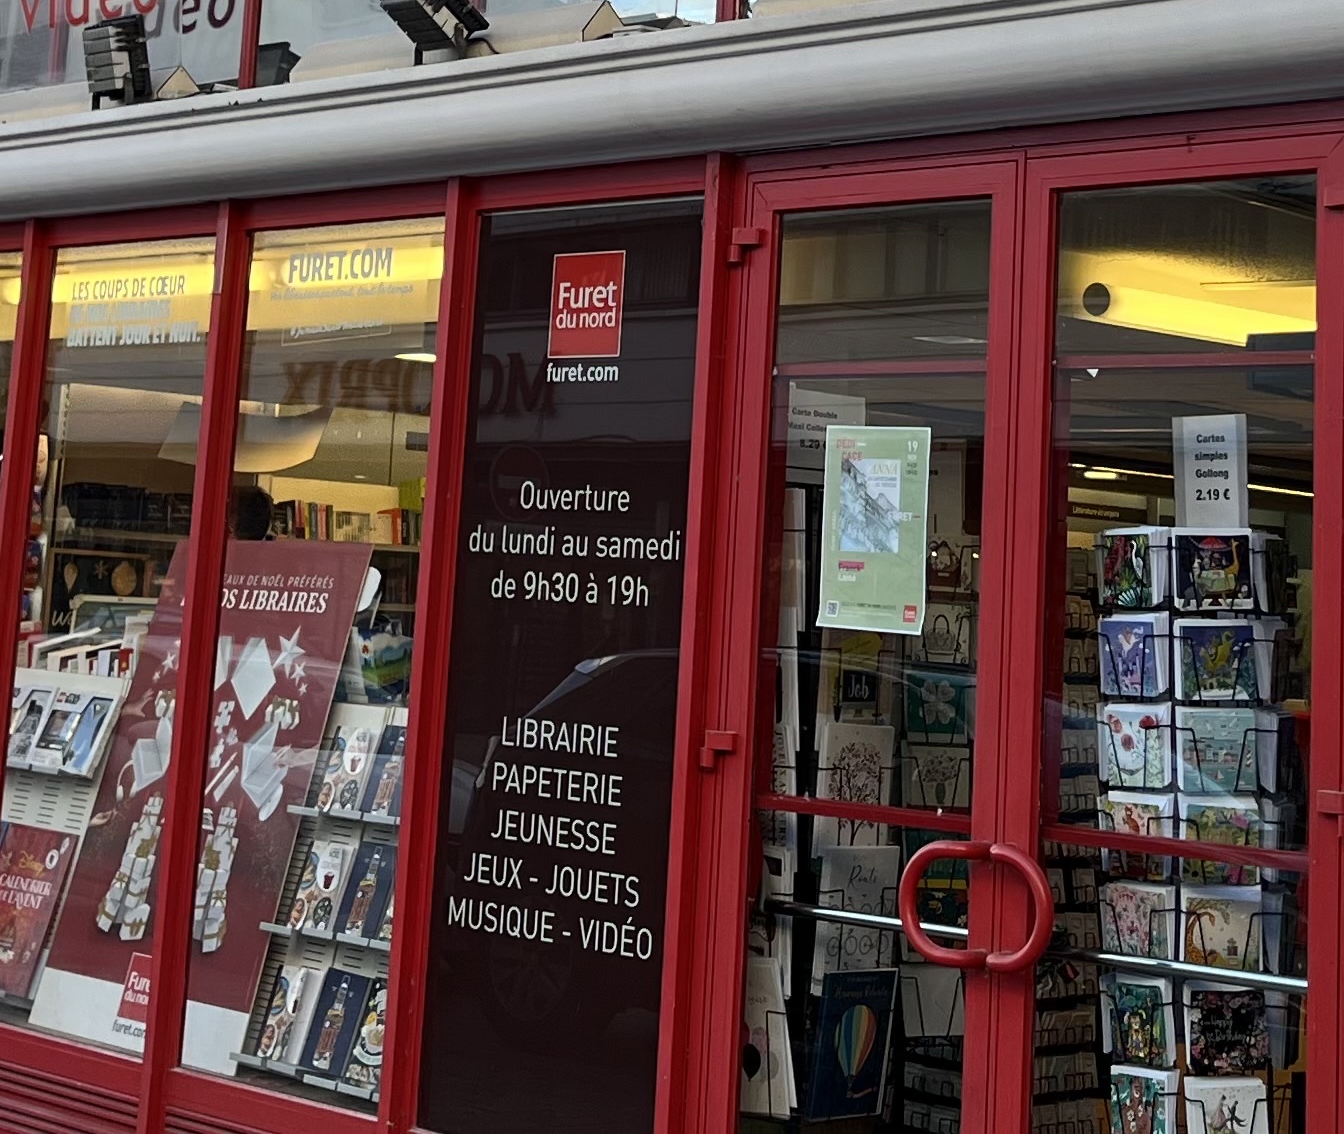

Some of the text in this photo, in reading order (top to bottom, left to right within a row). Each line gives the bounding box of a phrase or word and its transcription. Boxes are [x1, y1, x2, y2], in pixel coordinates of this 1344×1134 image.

[288, 247, 392, 283] FURET.COM
[72, 281, 90, 301] LES
[93, 278, 129, 300] COUPS
[132, 277, 146, 297] DE
[558, 280, 618, 309] Furet
[556, 307, 616, 329] du nord
[119, 324, 151, 346] JOUR
[546, 362, 619, 383] furet.com
[907, 440, 919, 453] 19
[1196, 433, 1226, 444] Cartes
[1194, 451, 1229, 463] simples
[1195, 468, 1229, 480] Gollong
[519, 480, 631, 512] Ouverture
[1195, 488, 1231, 501] 2.19 €
[469, 524, 681, 561] du lundi au samedi
[246, 574, 259, 587] DE
[287, 574, 335, 589] PRÉFÉRÉS
[491, 570, 649, 607] de 9h30 à 19h
[239, 589, 329, 614] LIBRAIRES
[502, 716, 619, 758] LIBRAIRIE
[492, 762, 623, 807] PAPETERIE
[491, 809, 617, 855] JEUNESSE
[464, 852, 523, 889] JEUX
[545, 864, 640, 908] JOUETS
[448, 896, 555, 943] MUSIQUE
[579, 916, 653, 960] VIDÉO
[124, 989, 136, 1003] du
